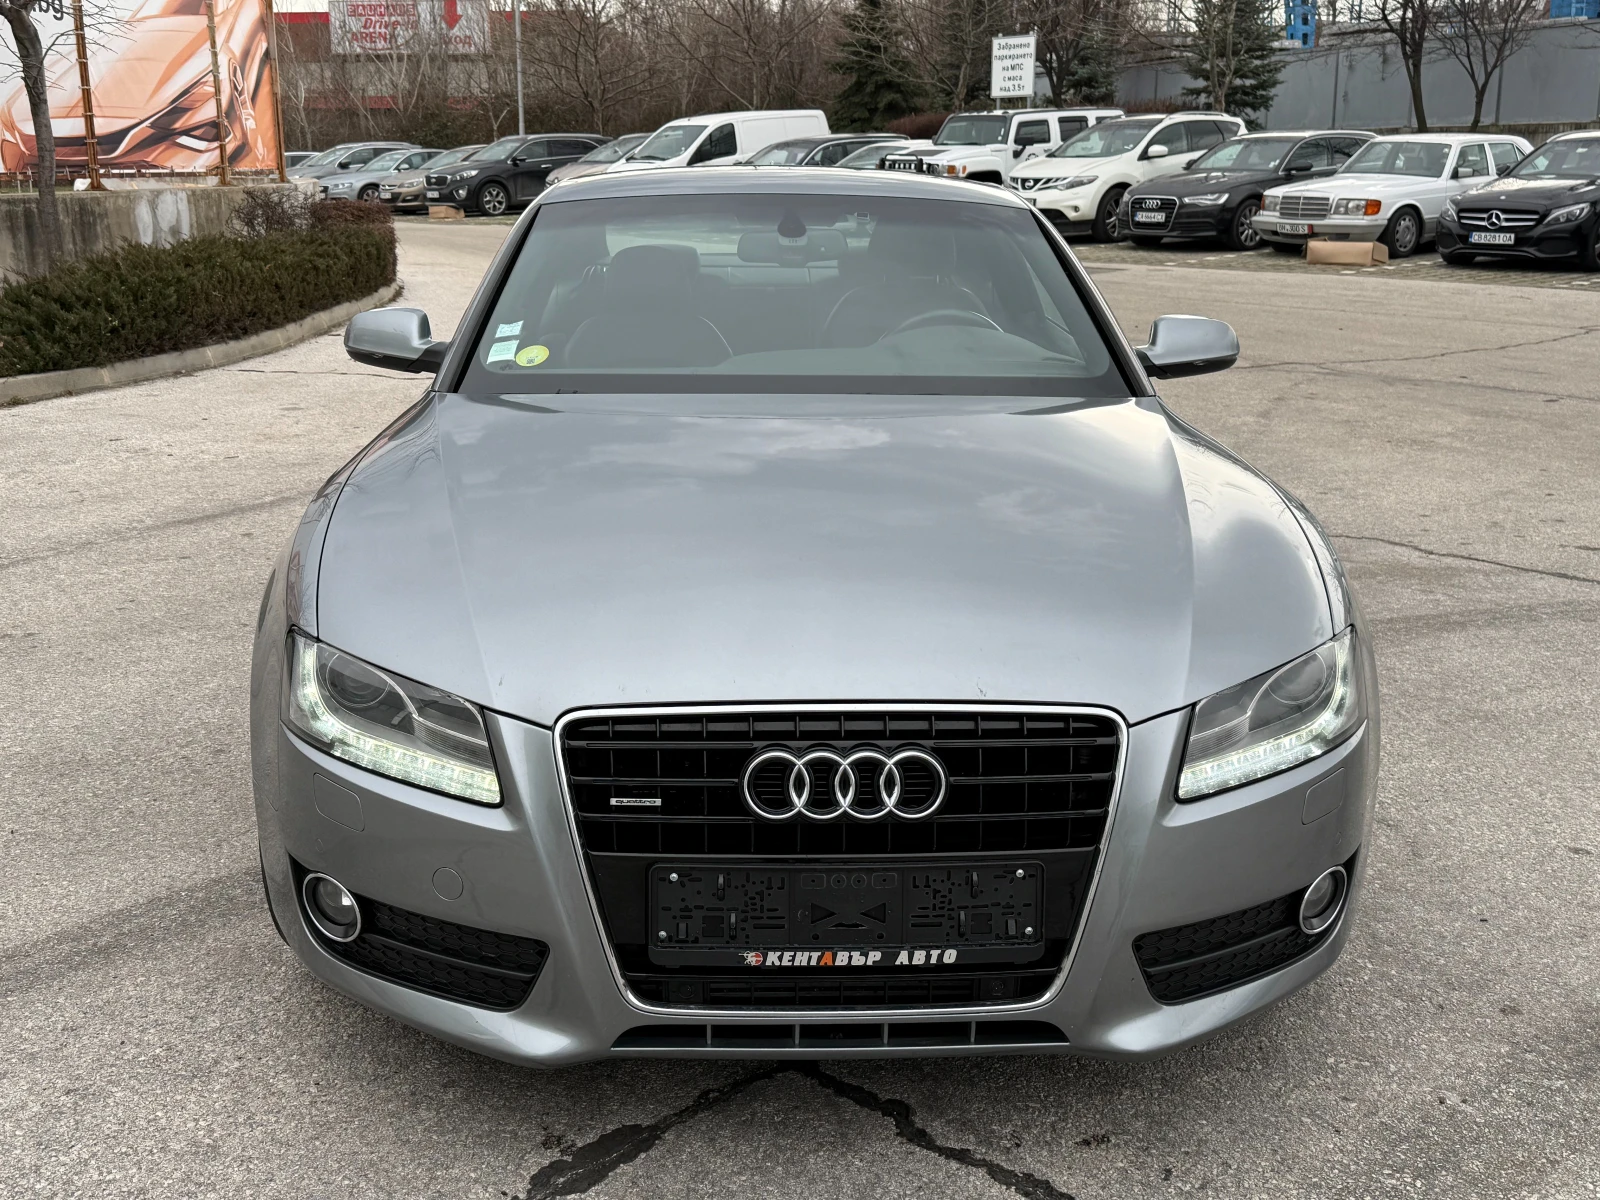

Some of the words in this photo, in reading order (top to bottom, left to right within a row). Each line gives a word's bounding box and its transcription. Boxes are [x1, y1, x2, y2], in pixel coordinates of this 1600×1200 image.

[997, 42, 1031, 51] Забранено
[994, 52, 1033, 62] паркирането
[1010, 63, 1024, 71] МПС
[765, 951, 882, 966] КЕНТАВЪР
[894, 949, 957, 965] АВТО
